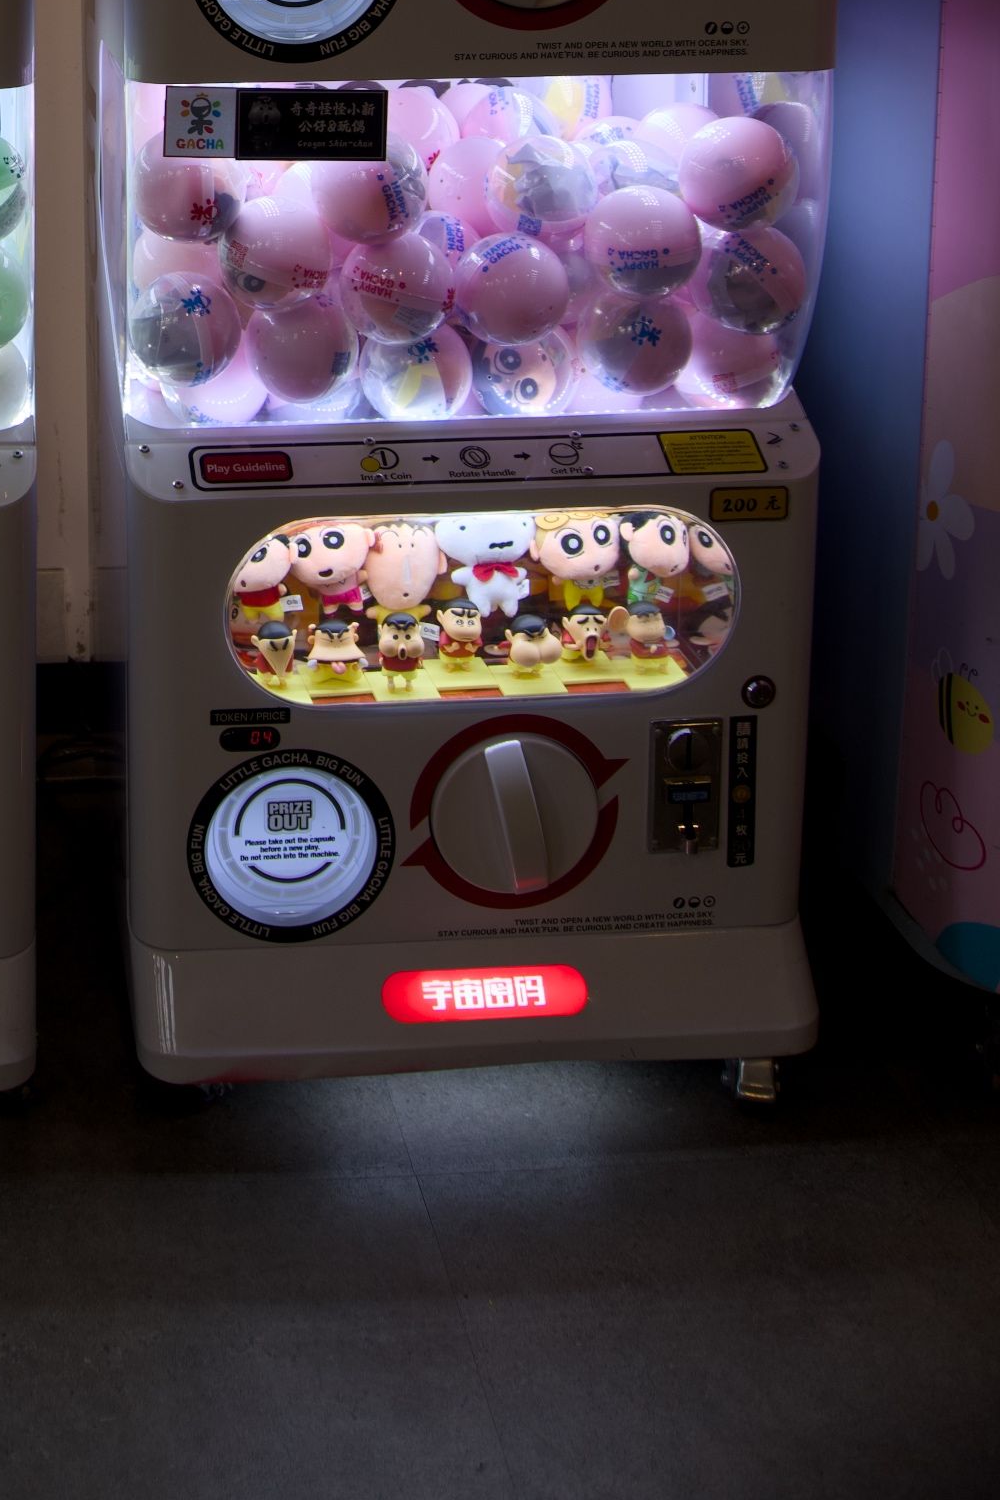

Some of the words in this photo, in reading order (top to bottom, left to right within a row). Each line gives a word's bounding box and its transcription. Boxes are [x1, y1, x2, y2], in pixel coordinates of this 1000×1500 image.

[176, 138, 225, 150] GACHA
[483, 238, 514, 259] HAPPY
[489, 243, 523, 264] GACHA
[618, 250, 658, 260] GACHA
[624, 260, 659, 270] HAPPY
[360, 270, 394, 288] GACHA
[360, 281, 393, 298] HAPPY
[206, 463, 230, 475] Play
[232, 461, 286, 474] Guideline
[390, 472, 412, 480] Coin
[449, 470, 480, 479] Rotate
[481, 468, 516, 477] Handle
[722, 497, 757, 513] 200
[765, 496, 781, 511] 元
[215, 713, 247, 723] TOKEN
[256, 712, 286, 721] PRICE
[250, 730, 273, 746] 04
[219, 760, 260, 791] LITTLE
[316, 755, 338, 772] BIG
[339, 764, 364, 787] FUN
[268, 801, 312, 814] PRIZE
[268, 813, 311, 831] OUT
[422, 975, 546, 1012] 宇宙密码
